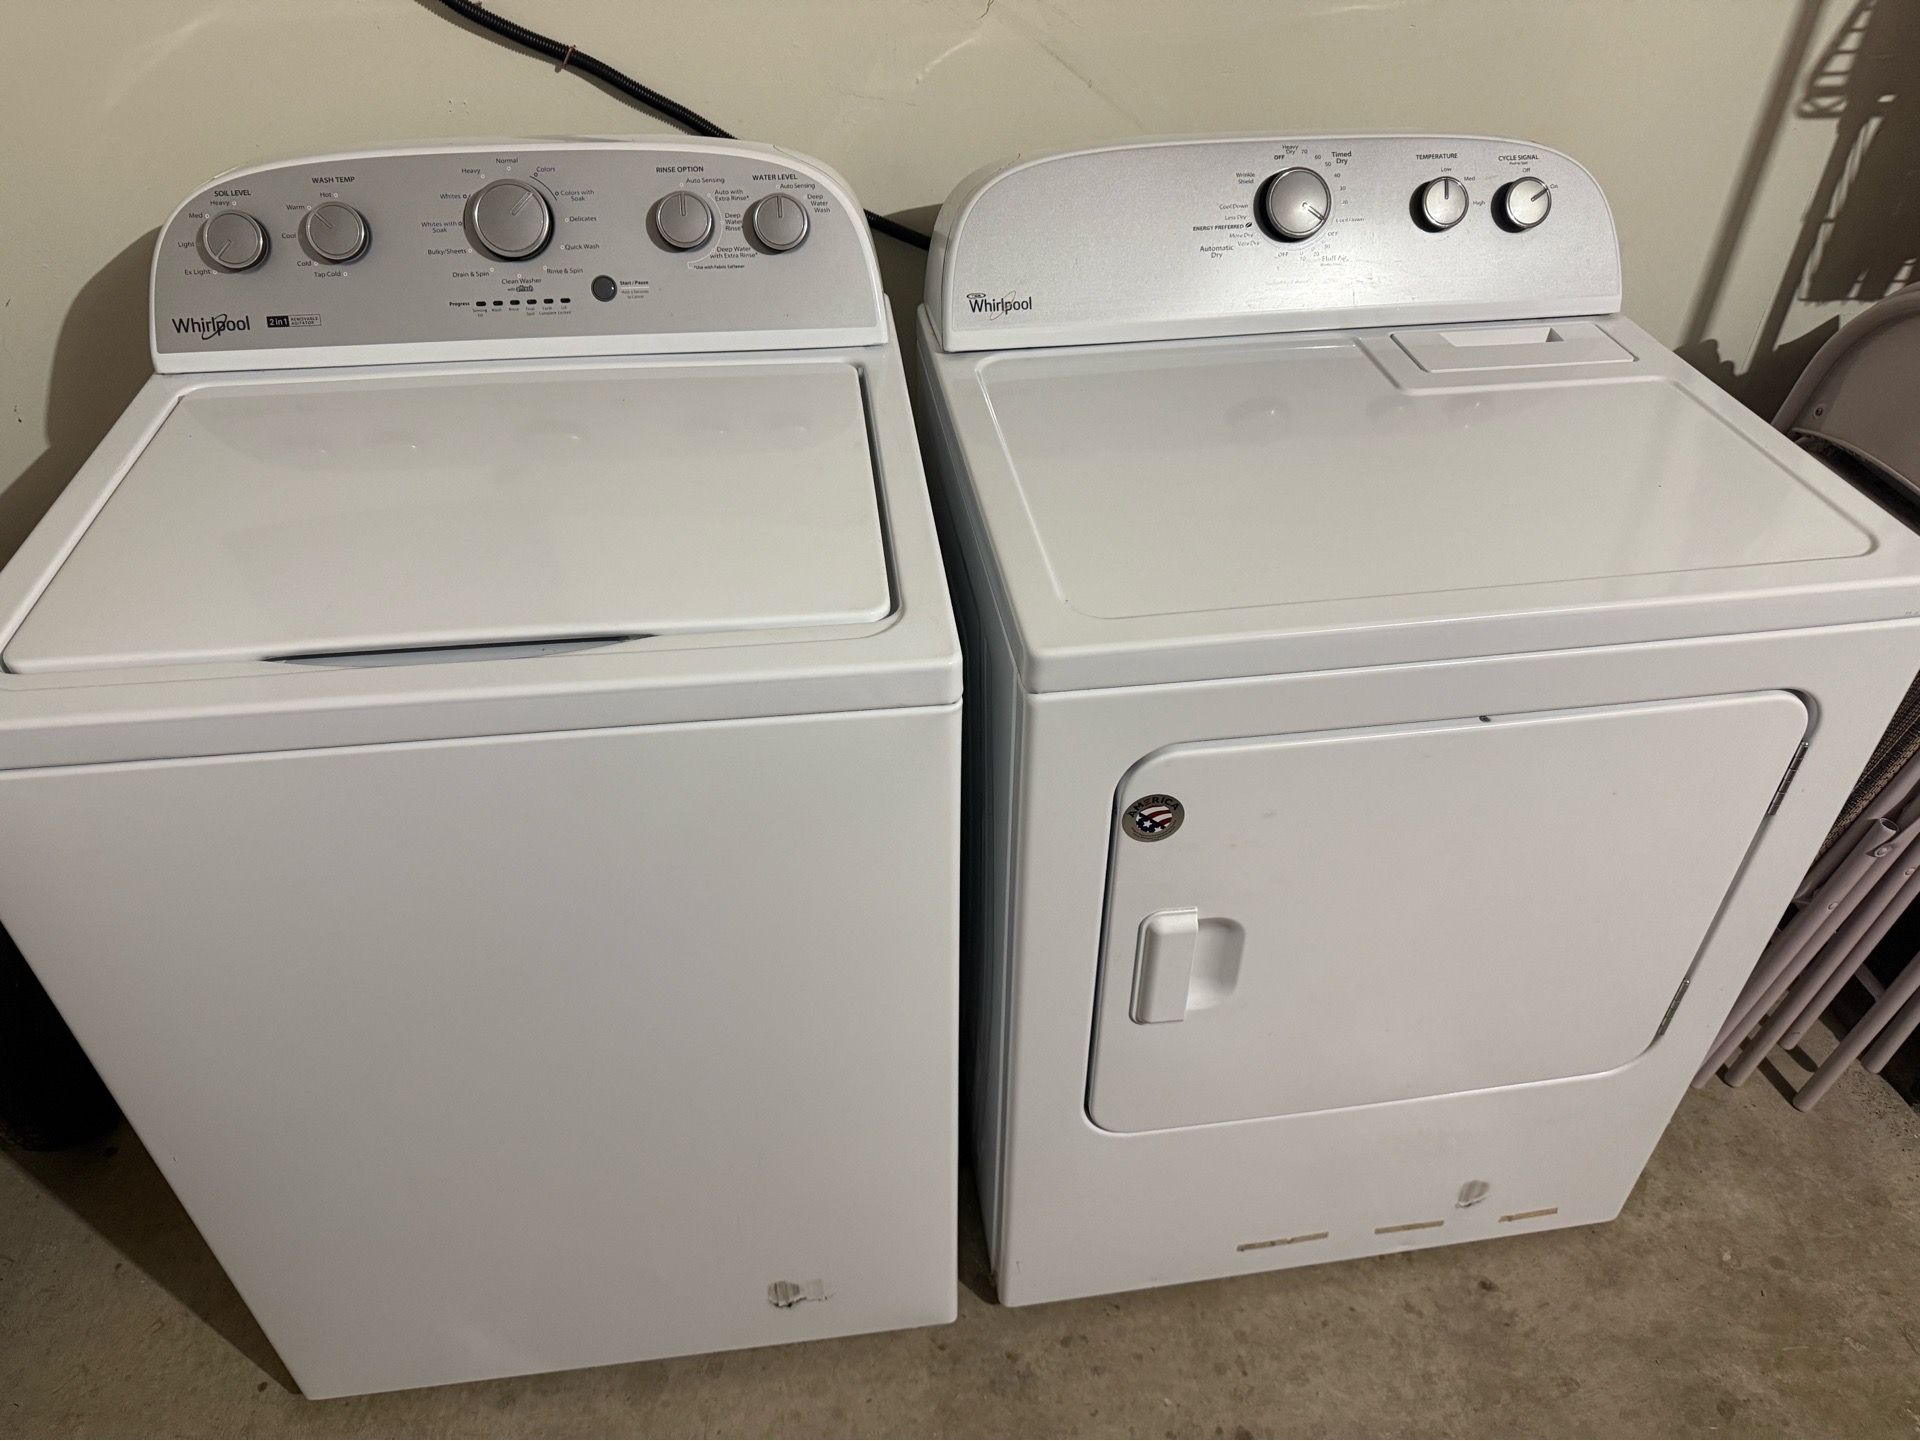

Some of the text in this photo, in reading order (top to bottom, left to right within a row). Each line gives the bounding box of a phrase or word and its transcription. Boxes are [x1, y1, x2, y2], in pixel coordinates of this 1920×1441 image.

[969, 296, 1032, 315] Whirlpool
[172, 314, 250, 340] Whirlpool
[1128, 797, 1180, 818] AMERICA
